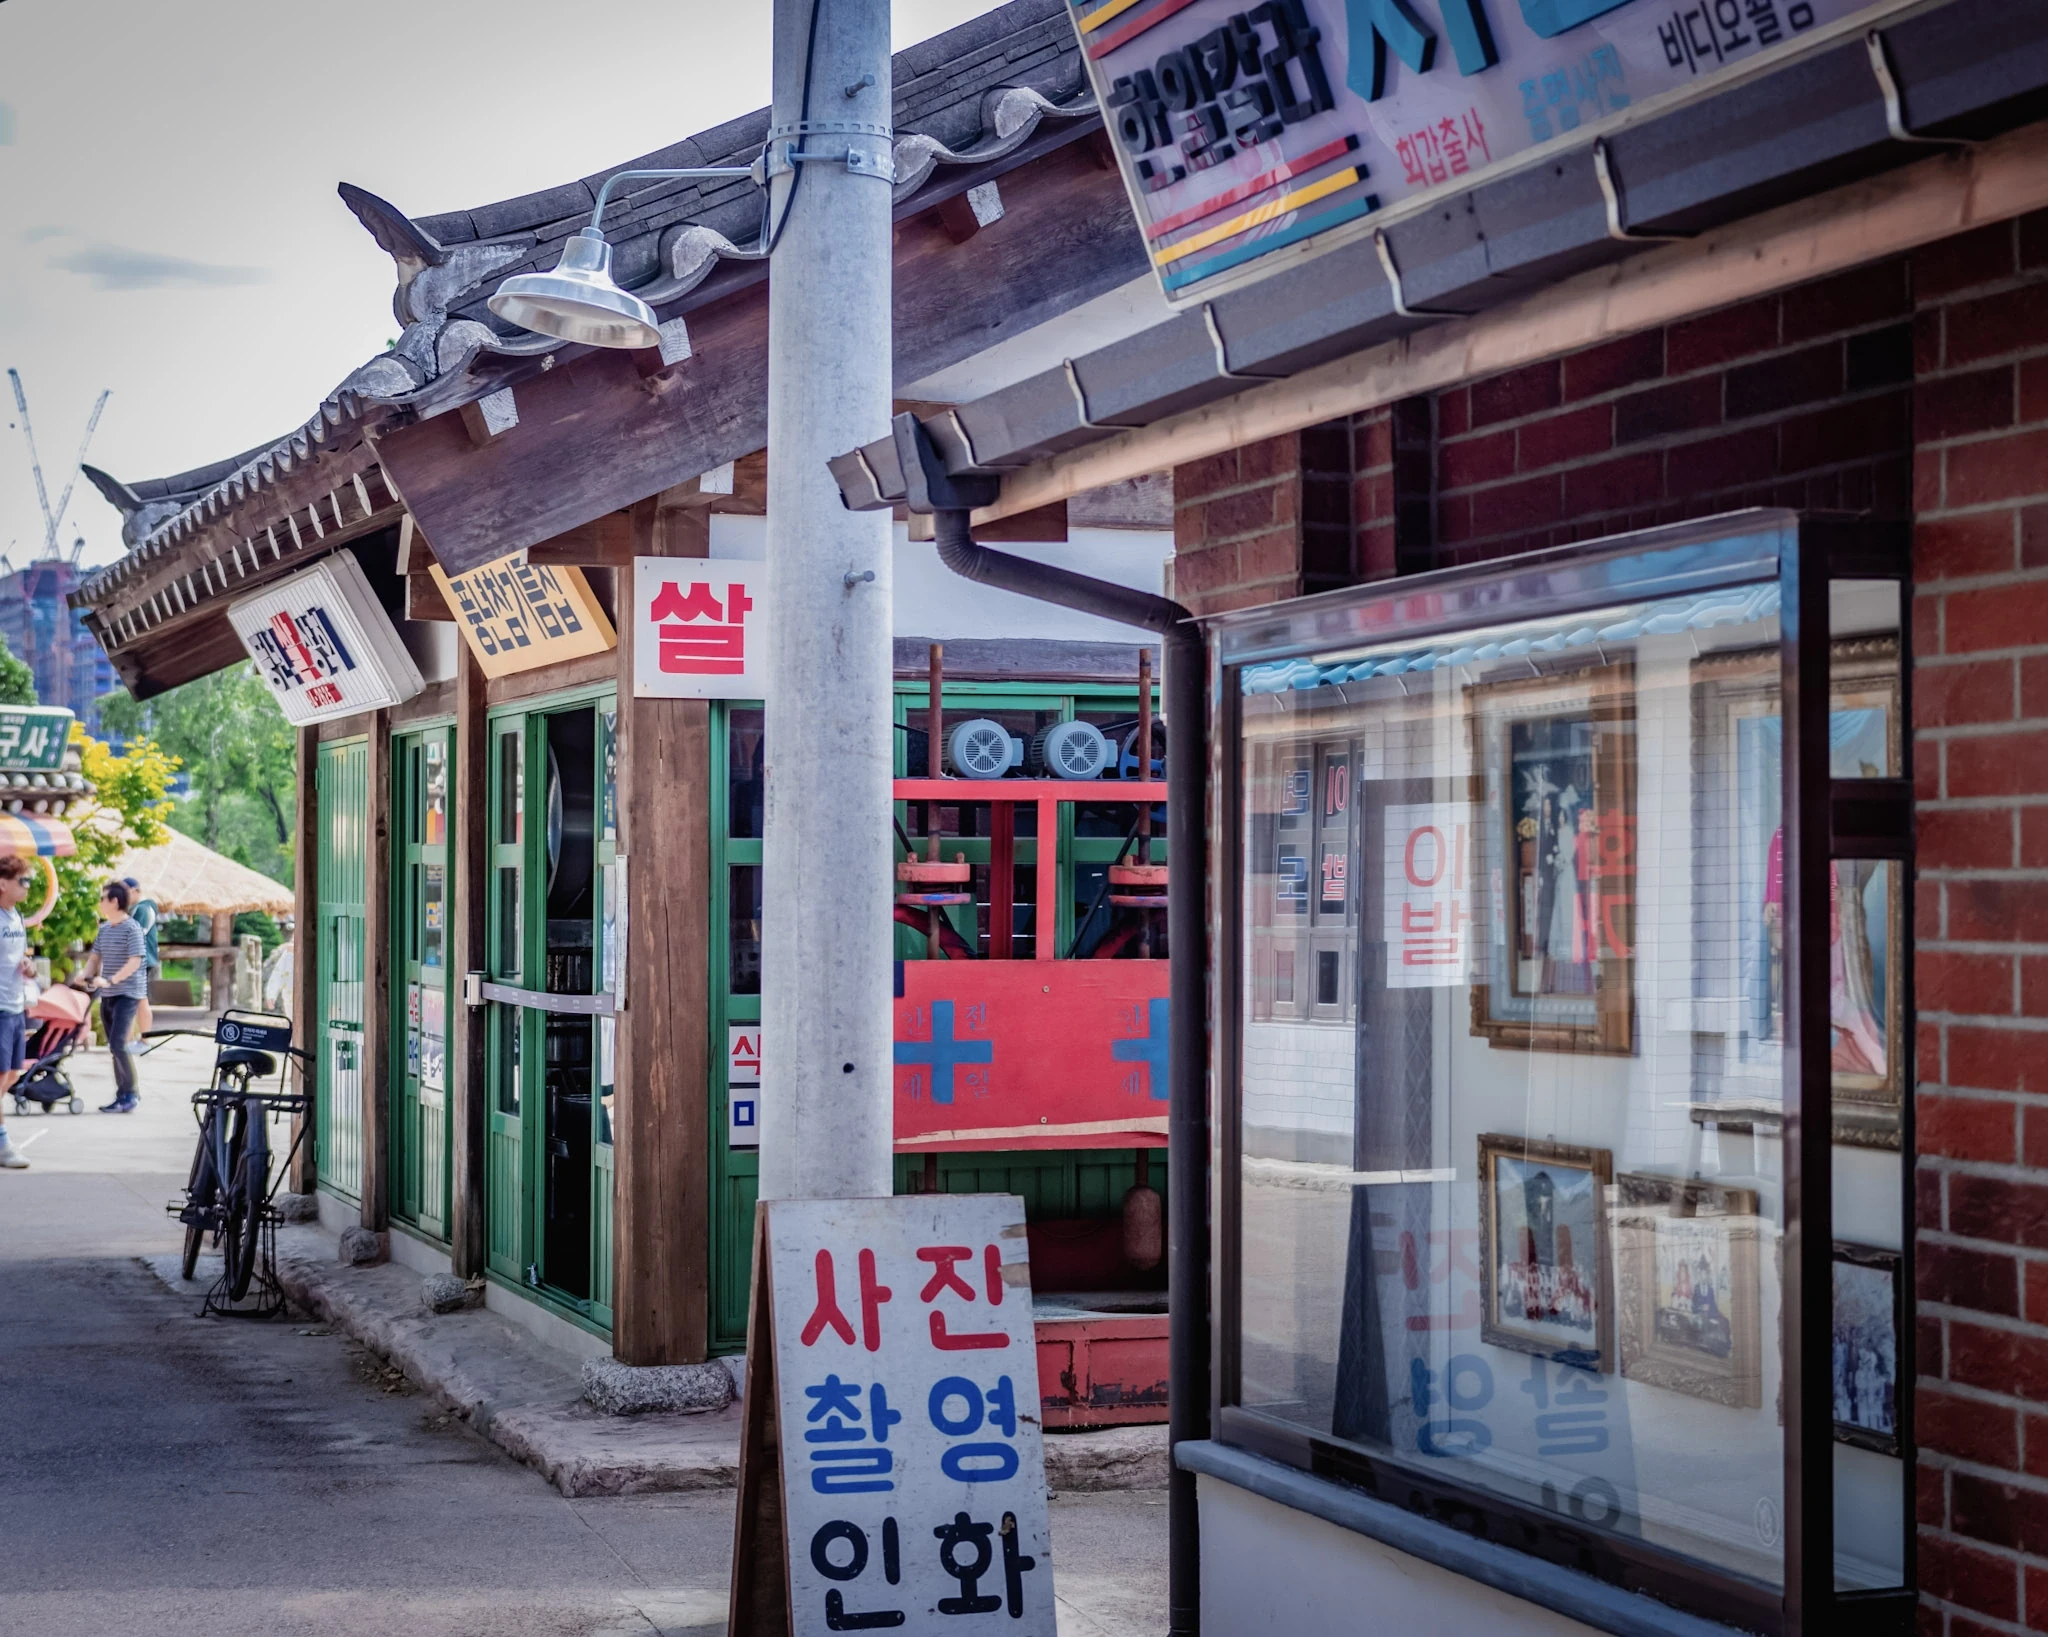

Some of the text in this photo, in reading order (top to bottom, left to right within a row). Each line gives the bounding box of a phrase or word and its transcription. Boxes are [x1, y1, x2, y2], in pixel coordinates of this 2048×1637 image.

[1396, 107, 1491, 187] 회갑출사
[450, 557, 584, 656] 풍년참기름집
[650, 581, 753, 675] 쌀
[800, 1243, 1010, 1352] 사진
[804, 1374, 1020, 1495] 촬영
[810, 1511, 1036, 1631] 인화
